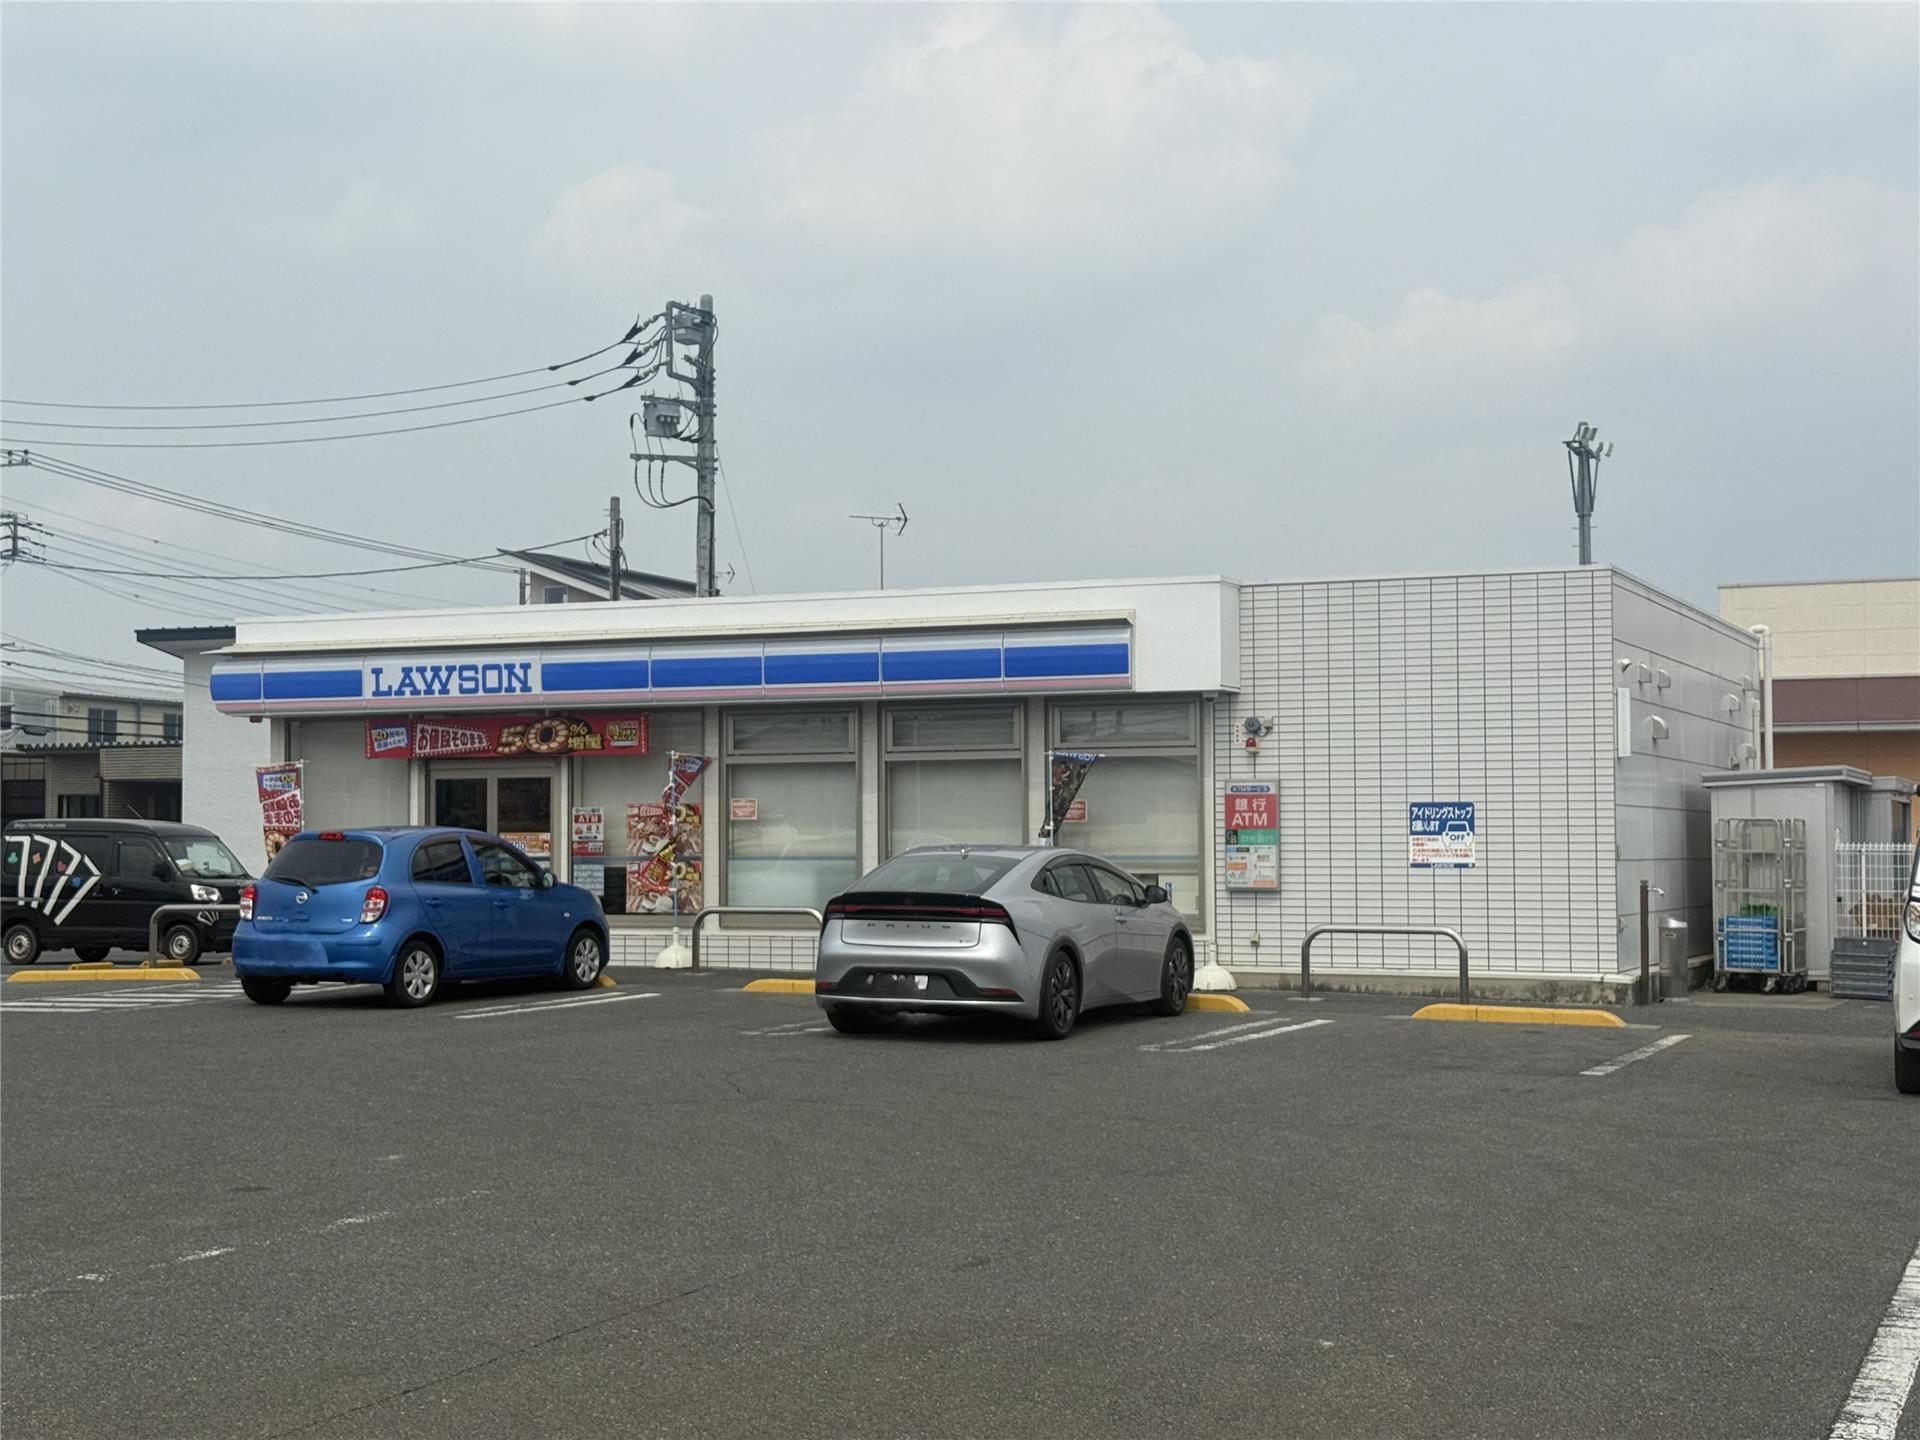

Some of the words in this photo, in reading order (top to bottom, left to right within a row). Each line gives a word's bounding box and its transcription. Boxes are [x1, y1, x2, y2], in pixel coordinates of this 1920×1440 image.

[371, 662, 532, 697] LAWSON
[417, 726, 486, 751] お値段そのまま
[1234, 798, 1267, 811] 銀行
[578, 815, 599, 823] ATM
[1231, 812, 1268, 826] ATM
[1411, 806, 1473, 819] アイドリングストップ
[1449, 833, 1465, 842] OFF
